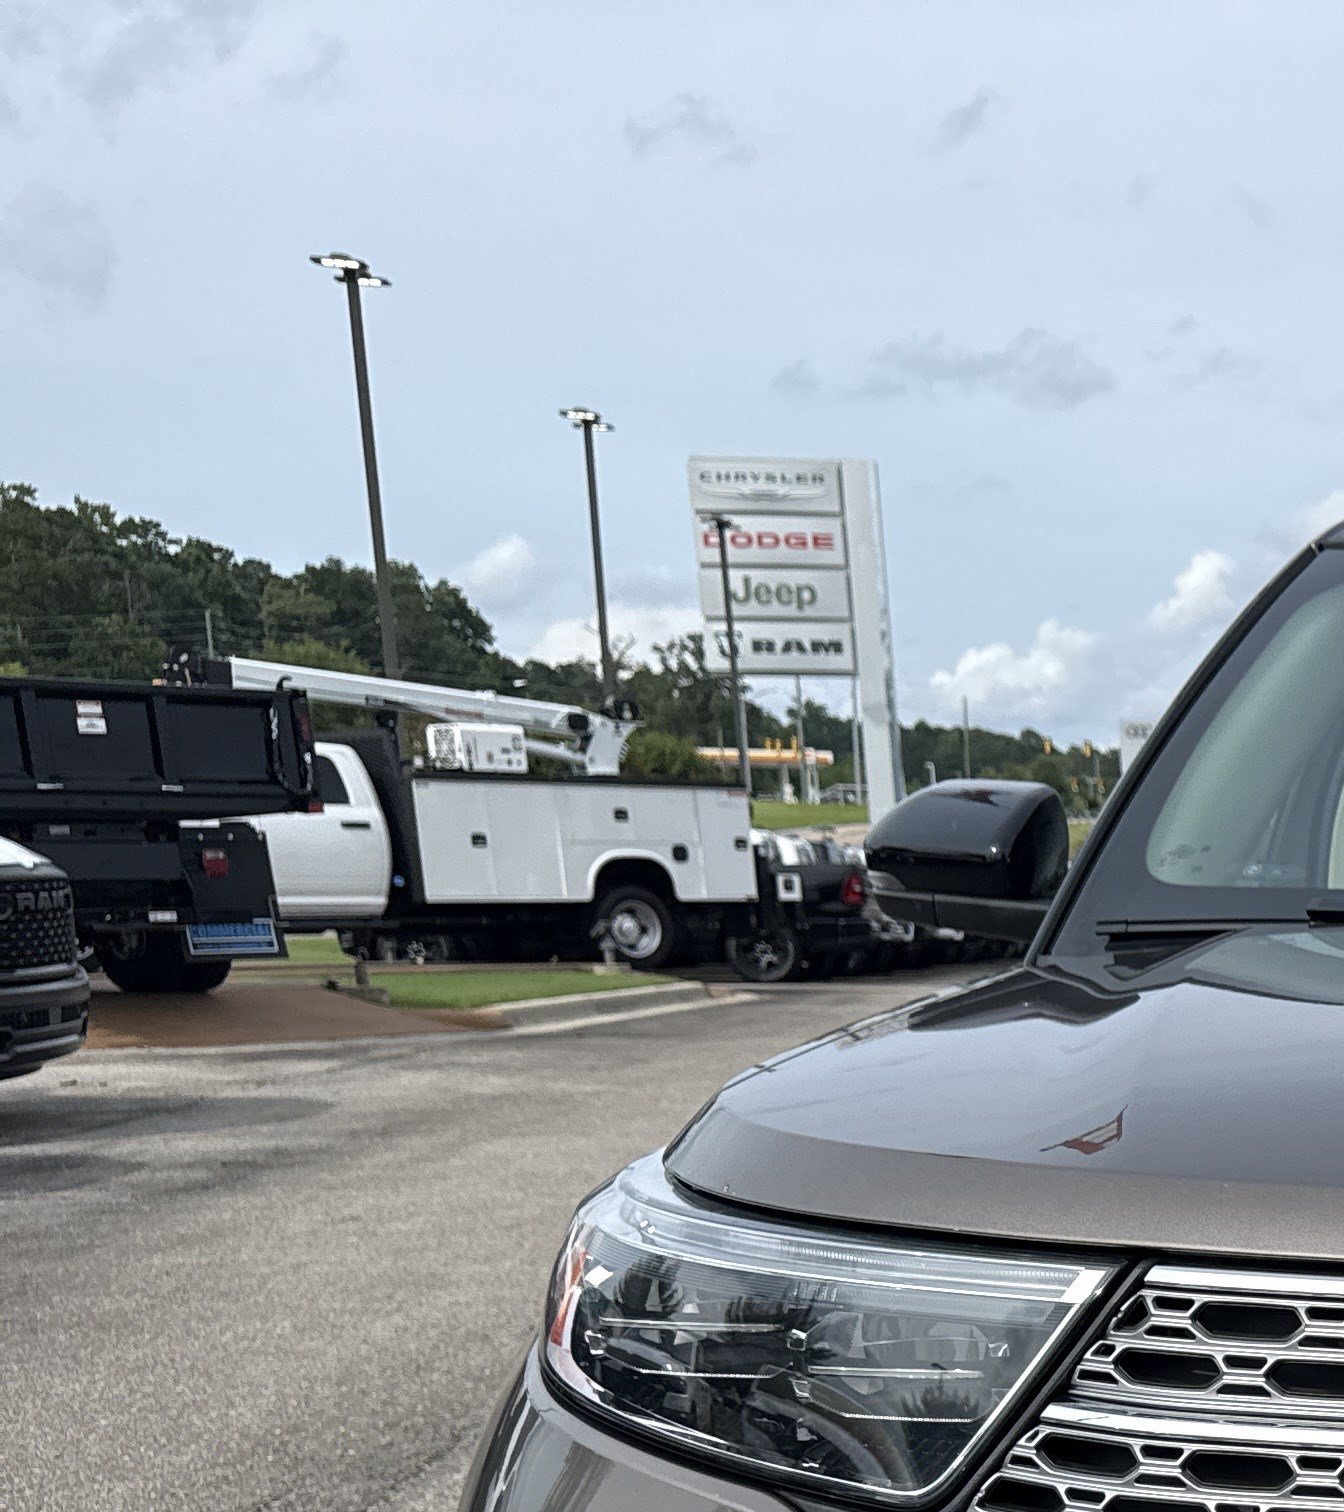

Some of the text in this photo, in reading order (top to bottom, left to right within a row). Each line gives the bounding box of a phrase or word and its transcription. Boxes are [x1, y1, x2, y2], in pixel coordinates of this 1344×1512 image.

[699, 470, 826, 485] CHRYSLER
[702, 530, 835, 551] DODGE
[729, 574, 818, 611] Jeep
[751, 637, 844, 657] RAM
